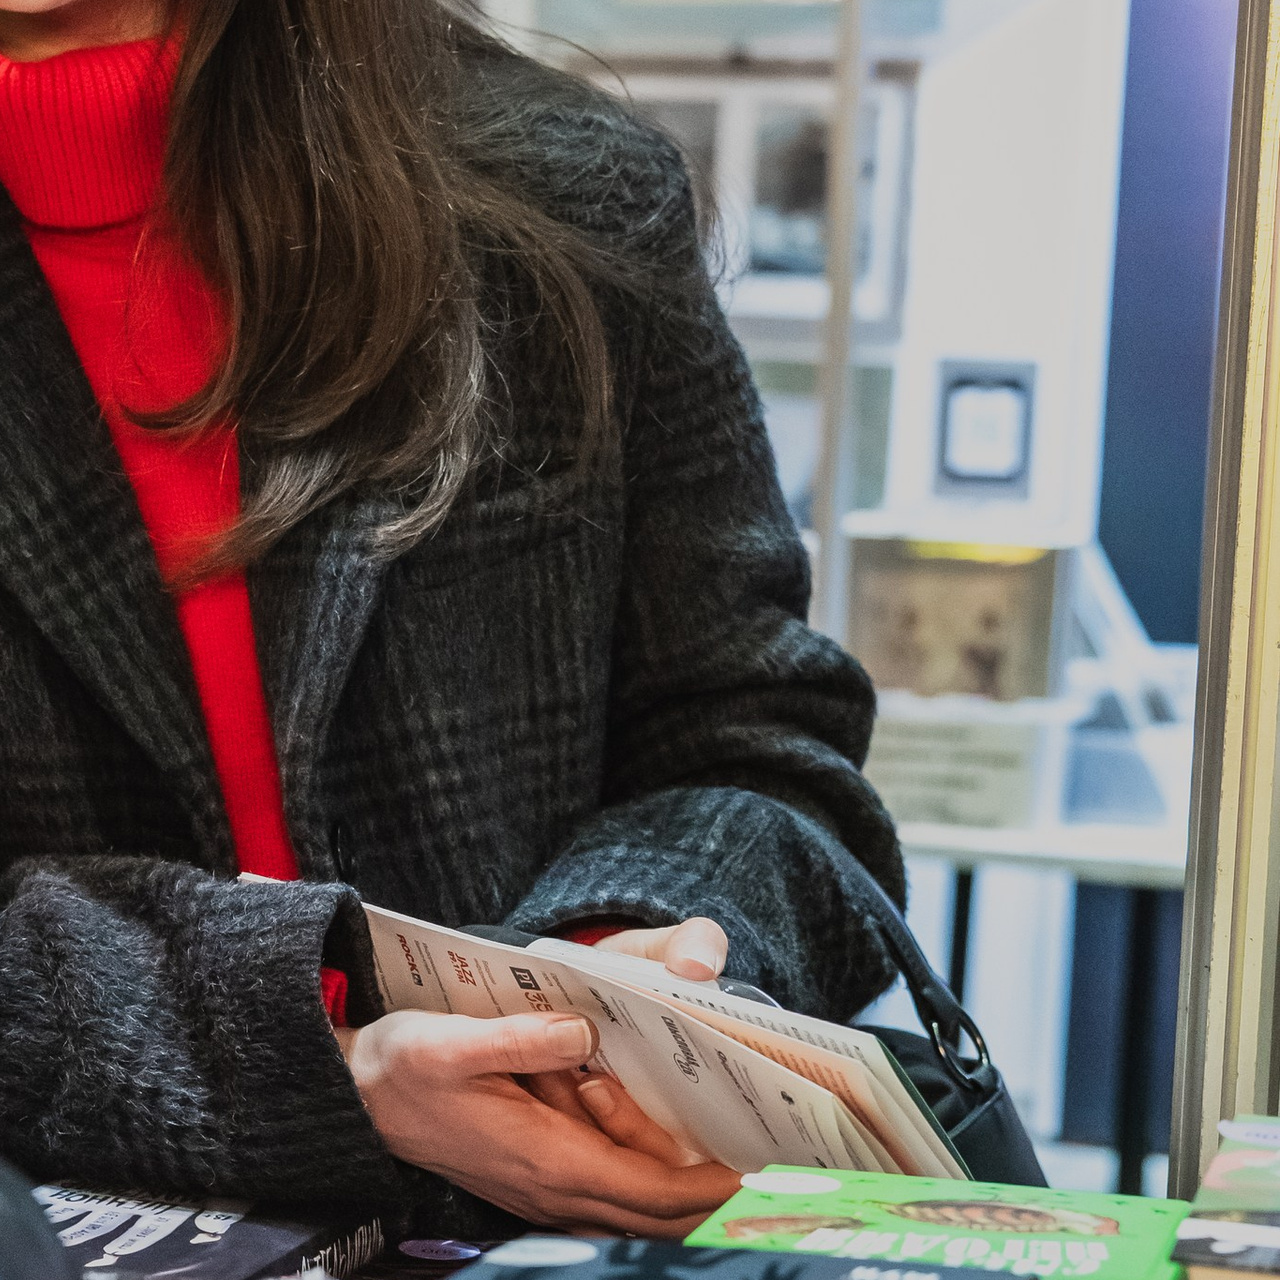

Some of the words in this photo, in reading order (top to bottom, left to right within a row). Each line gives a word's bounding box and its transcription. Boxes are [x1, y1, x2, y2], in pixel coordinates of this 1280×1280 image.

[396, 933, 420, 974] ROCK
[455, 952, 477, 987] JAZZ
[595, 996, 623, 1028] РБК
